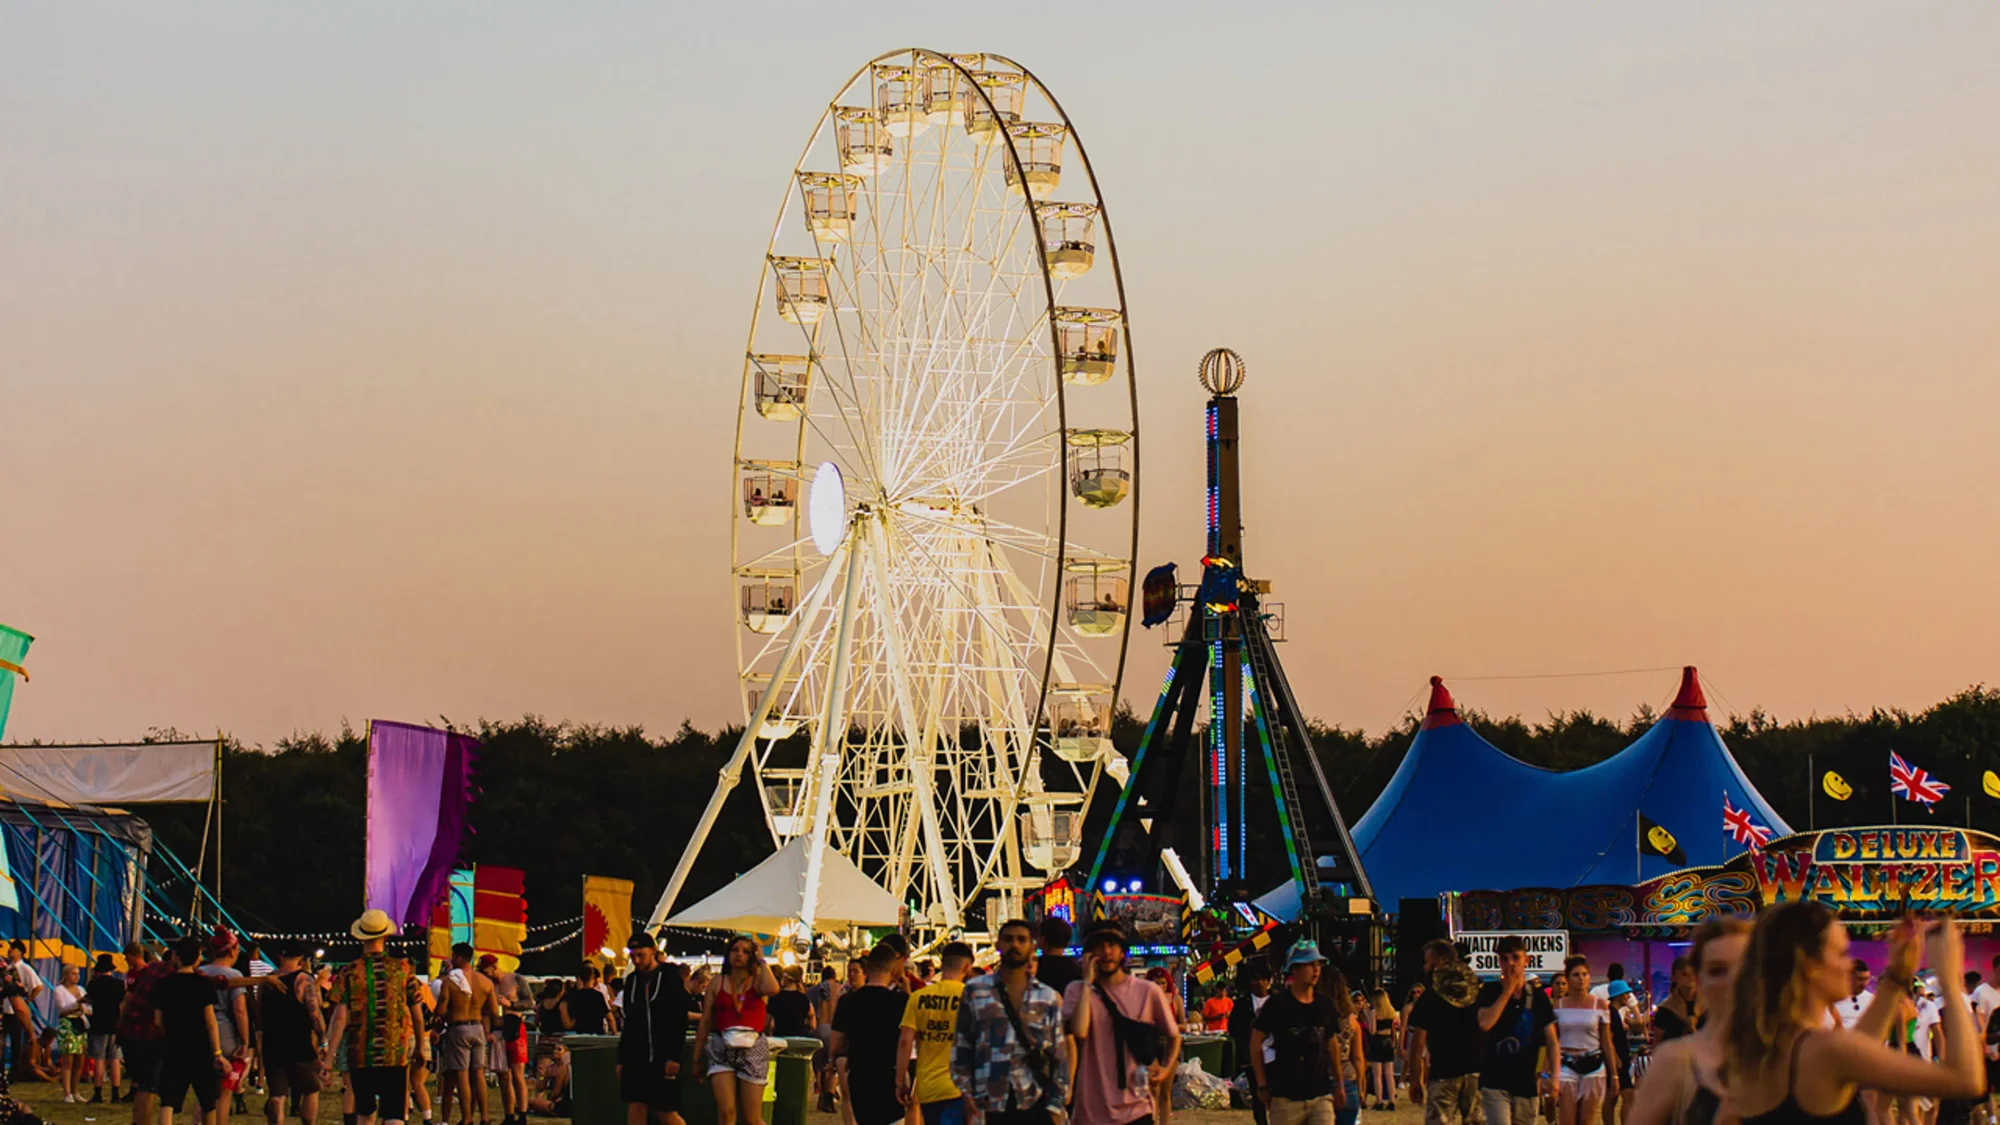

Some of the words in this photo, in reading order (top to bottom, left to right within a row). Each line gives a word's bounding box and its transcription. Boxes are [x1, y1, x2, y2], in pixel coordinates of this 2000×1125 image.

[1834, 831, 1956, 860] DELUXE
[1751, 849, 2000, 904] WALTZER
[1459, 936, 1499, 953] WALTZ
[1523, 935, 1564, 953] OKENS
[1476, 954, 1500, 970] SOL
[918, 995, 949, 1010] POSTY
